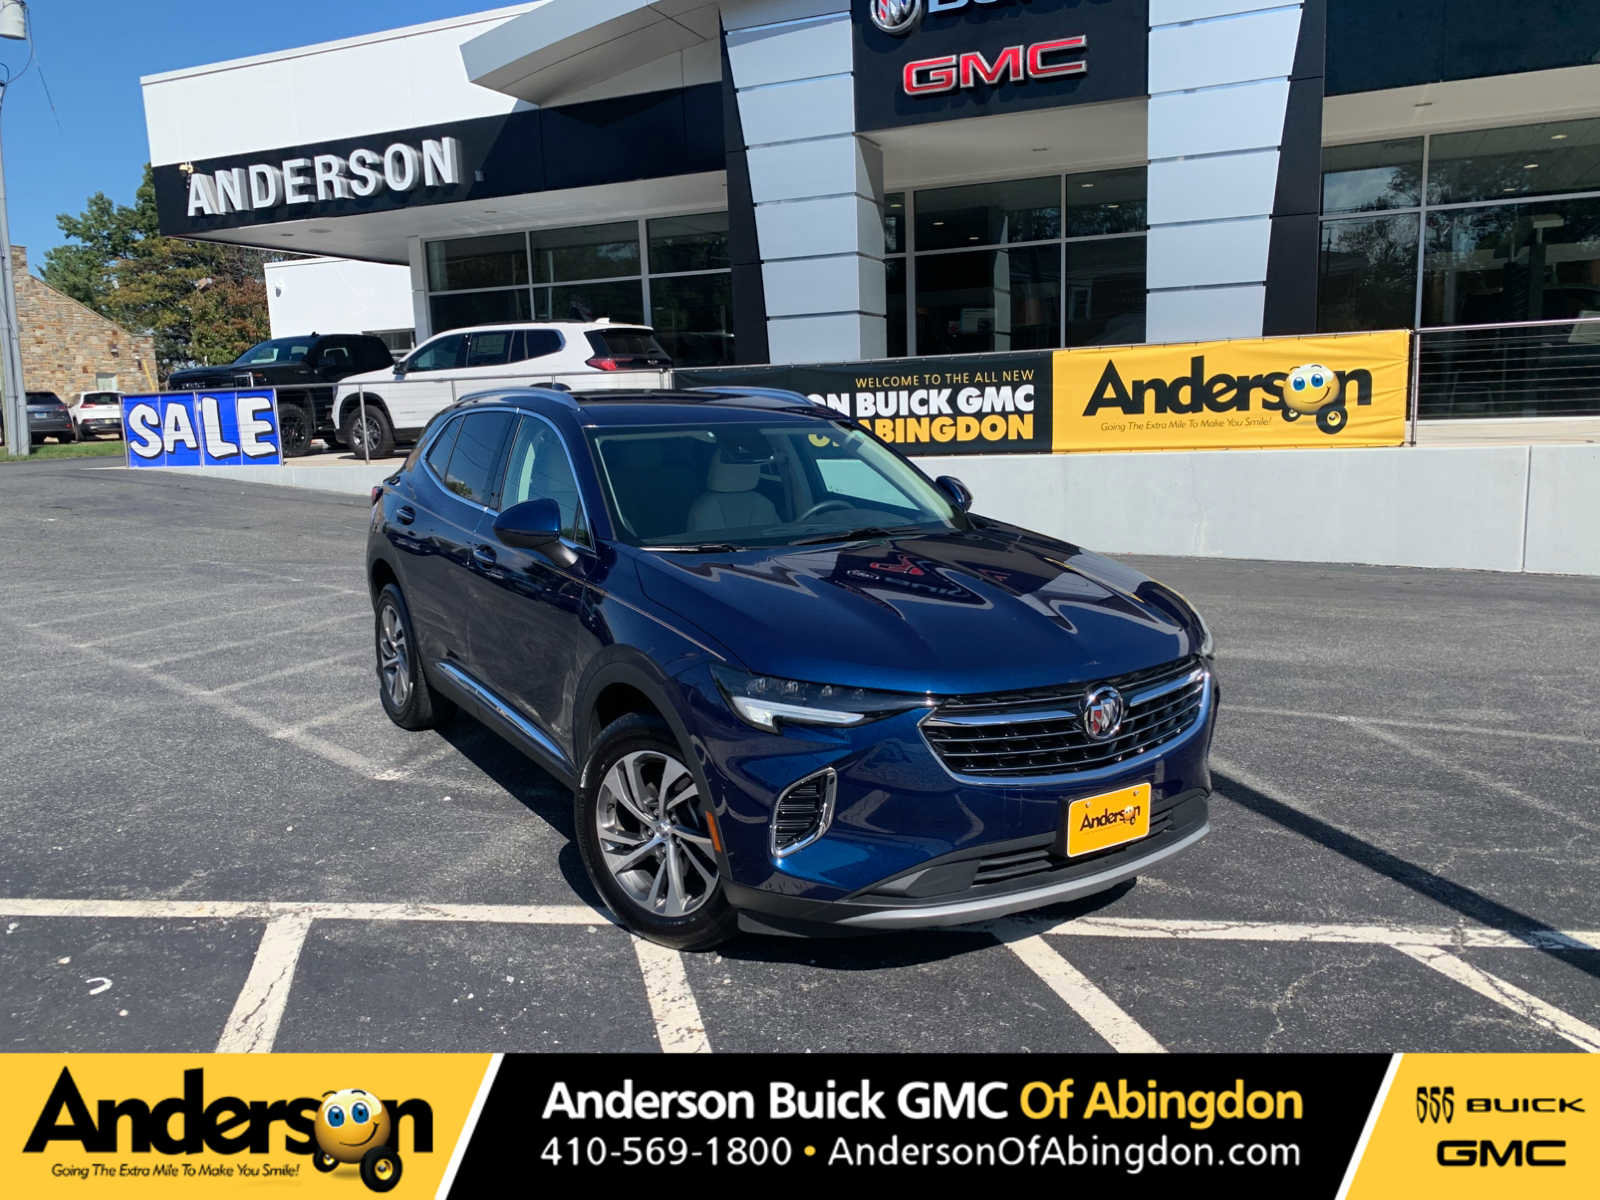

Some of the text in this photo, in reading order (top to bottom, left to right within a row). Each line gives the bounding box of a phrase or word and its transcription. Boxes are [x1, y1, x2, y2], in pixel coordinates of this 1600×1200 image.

[903, 35, 1087, 96] GMC
[187, 136, 461, 217] ANDERSON
[855, 369, 1035, 389] WELCOME TO THE ALL NEW
[855, 388, 954, 418] BUICK
[956, 384, 1034, 415] GMC
[128, 397, 278, 460] SALE
[1100, 416, 1272, 433] Going The Extra Mile To Make You Smile!
